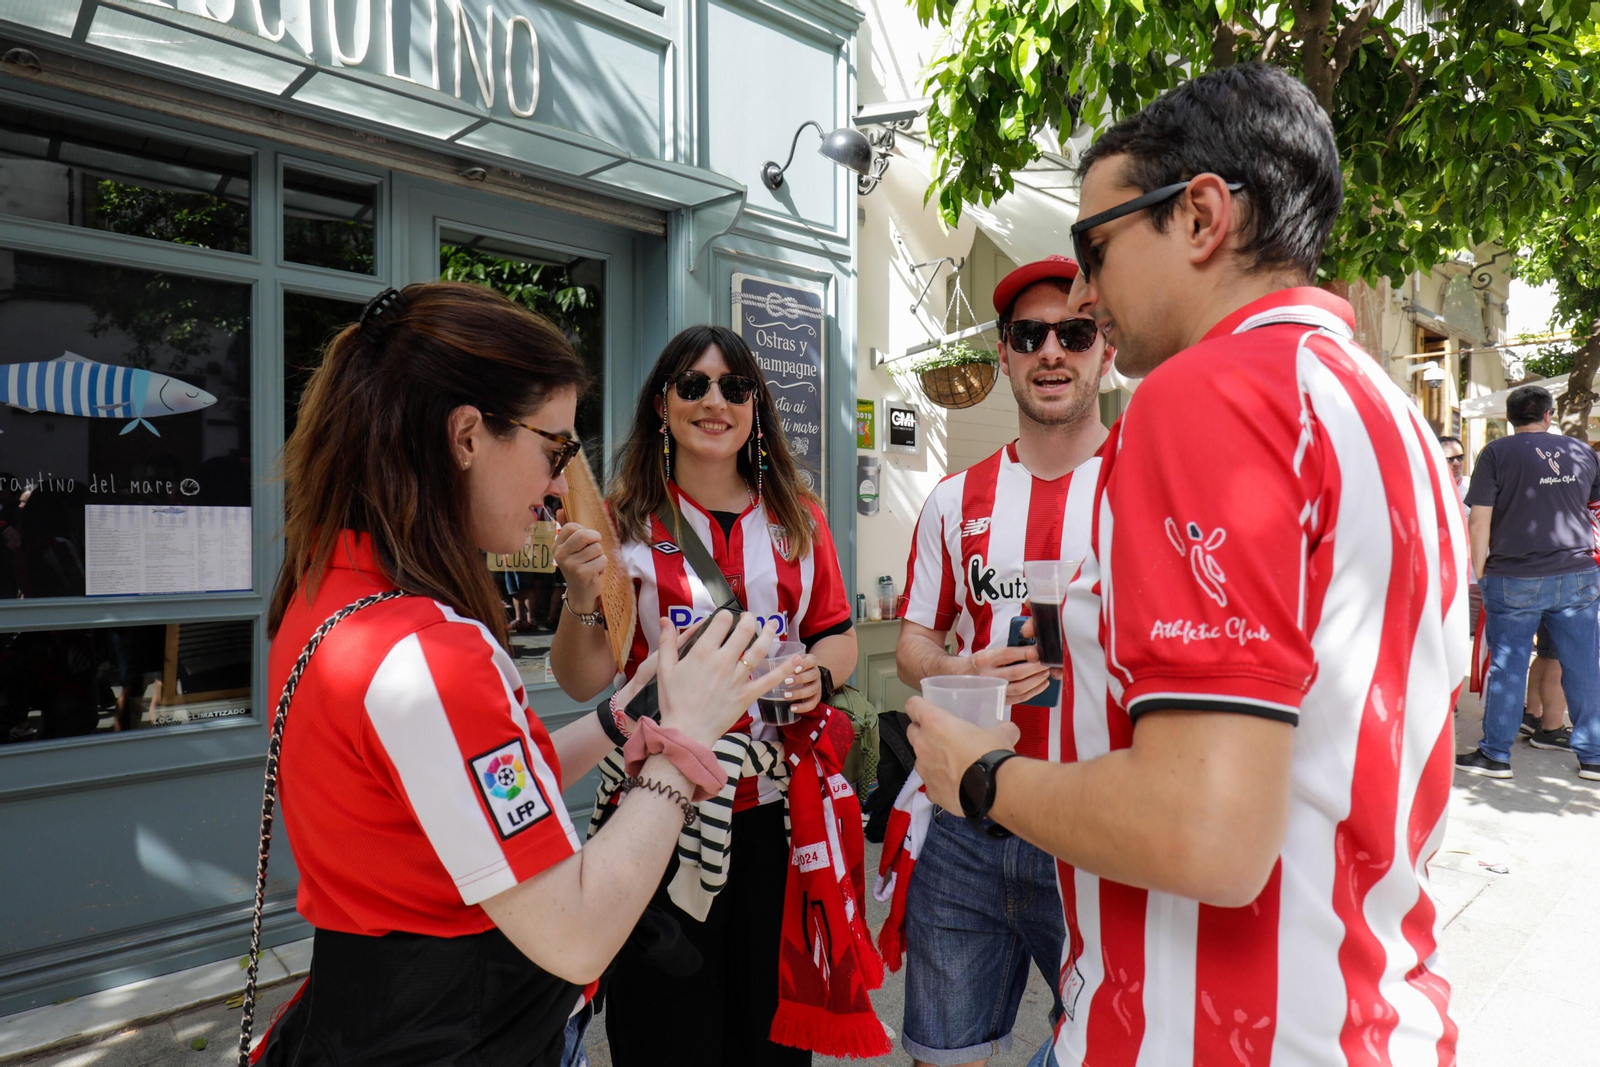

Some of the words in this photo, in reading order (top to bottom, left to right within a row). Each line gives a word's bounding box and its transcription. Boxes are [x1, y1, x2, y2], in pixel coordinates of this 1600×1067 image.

[756, 329, 796, 352] Ostras
[799, 340, 808, 357] y
[793, 400, 807, 414] ai
[792, 421, 820, 435] mare
[89, 472, 116, 494] del
[130, 478, 173, 494] mare
[1224, 616, 1271, 647] Club
[506, 800, 536, 827] LFP
